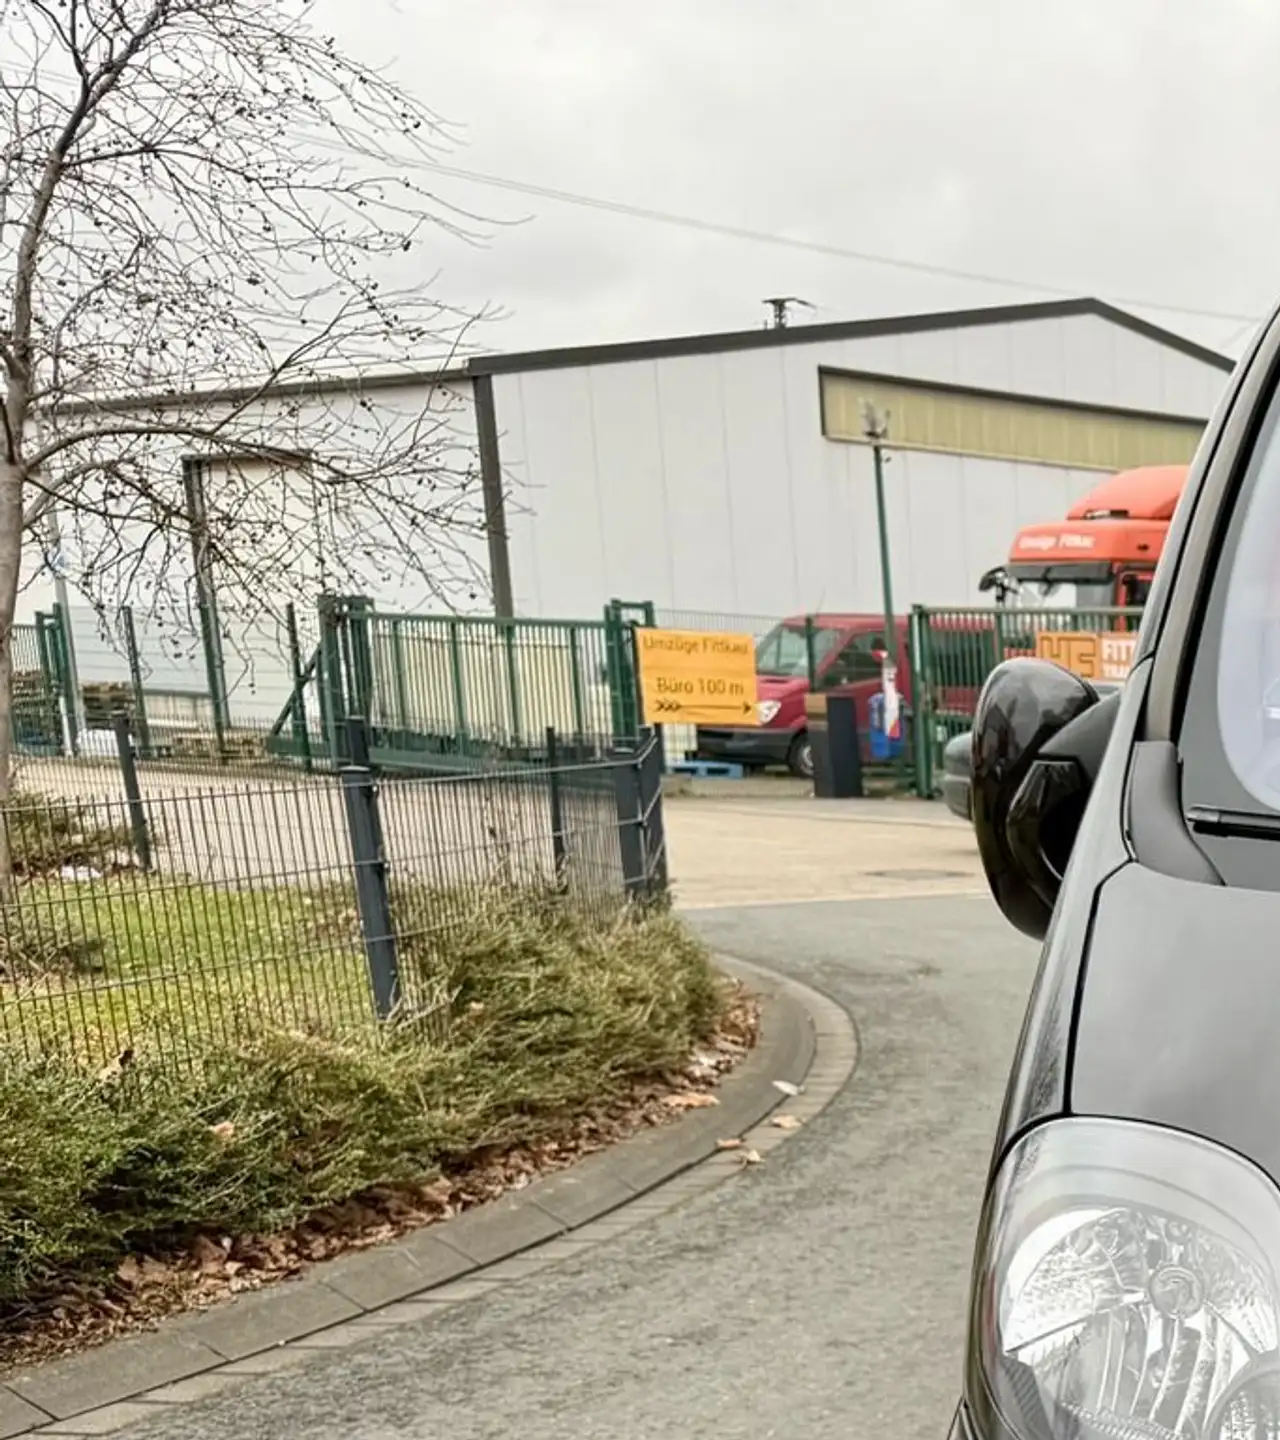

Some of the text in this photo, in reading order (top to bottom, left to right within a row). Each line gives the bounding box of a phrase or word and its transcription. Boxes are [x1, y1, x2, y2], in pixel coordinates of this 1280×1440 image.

[656, 676, 745, 695] Büro 100 m
